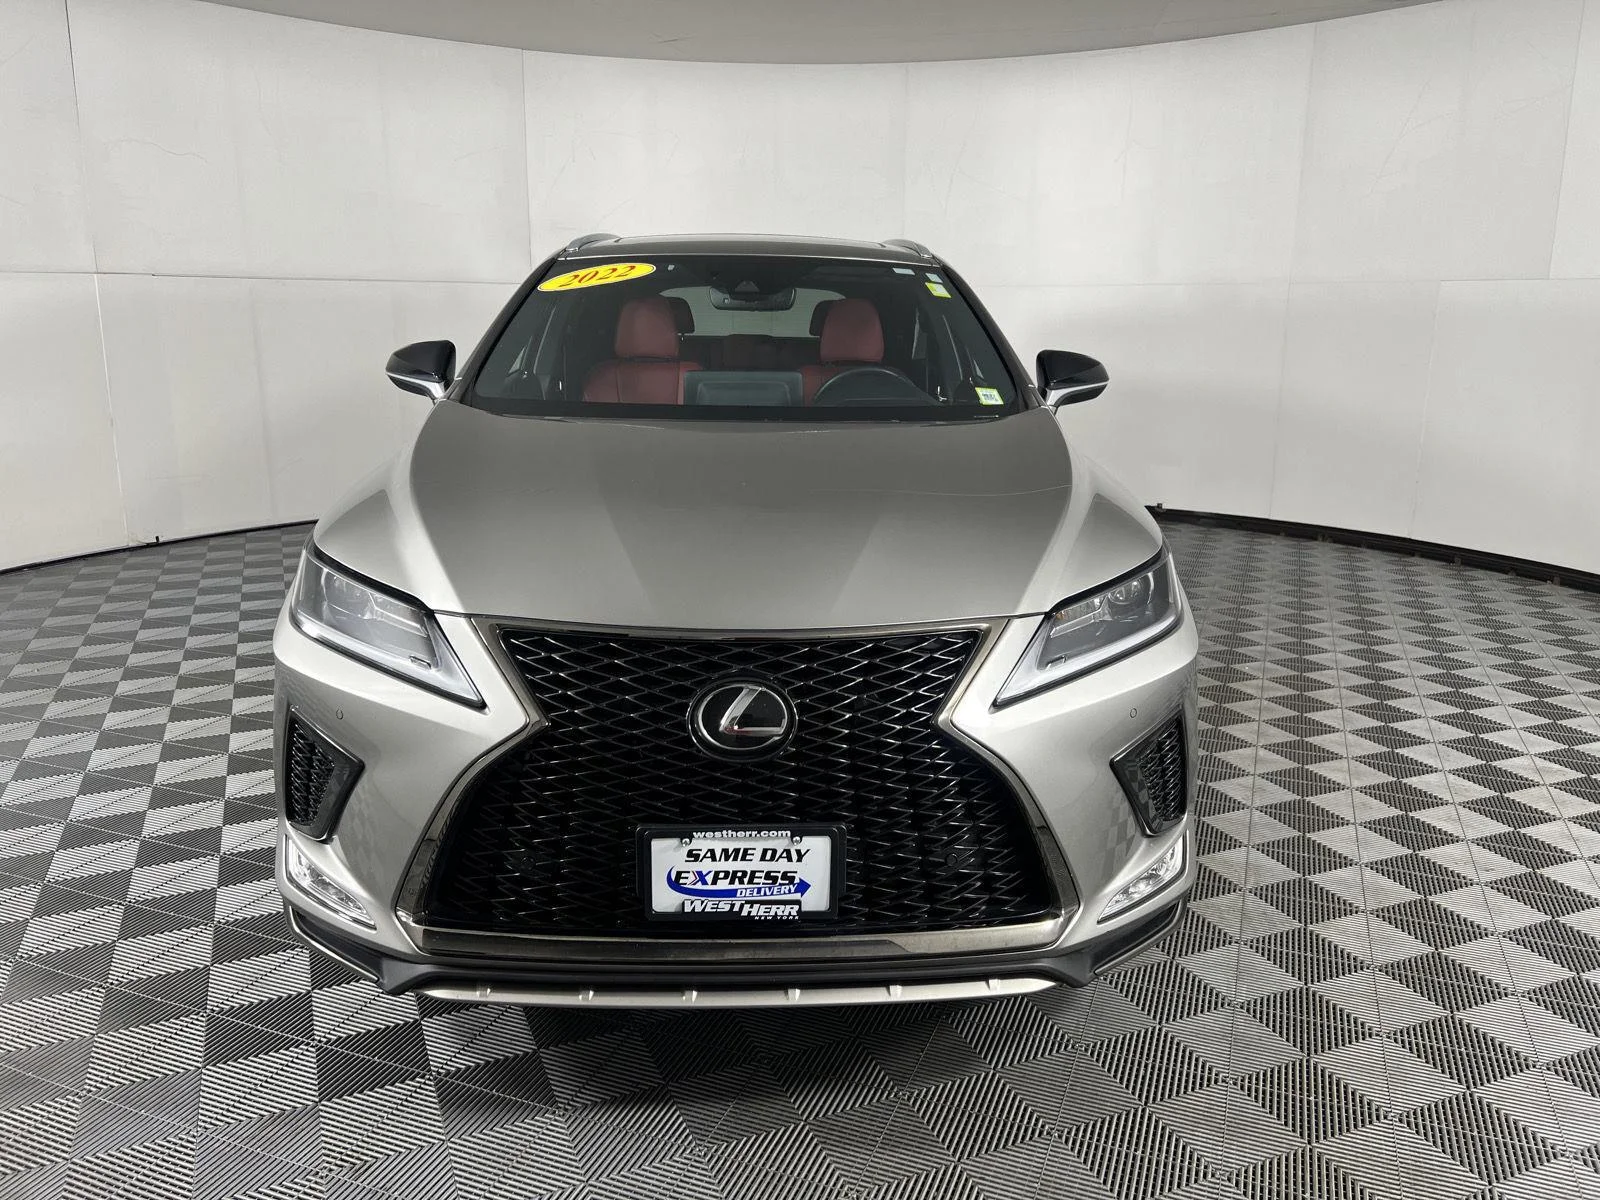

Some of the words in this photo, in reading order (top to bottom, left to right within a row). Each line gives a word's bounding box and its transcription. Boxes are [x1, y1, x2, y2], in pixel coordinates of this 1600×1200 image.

[557, 265, 636, 288] 2022
[692, 829, 791, 839] westherr.com
[684, 847, 756, 863] SAME
[759, 847, 811, 863] DAY
[673, 869, 798, 886] EXPRESS
[736, 883, 798, 898] DELIVERY
